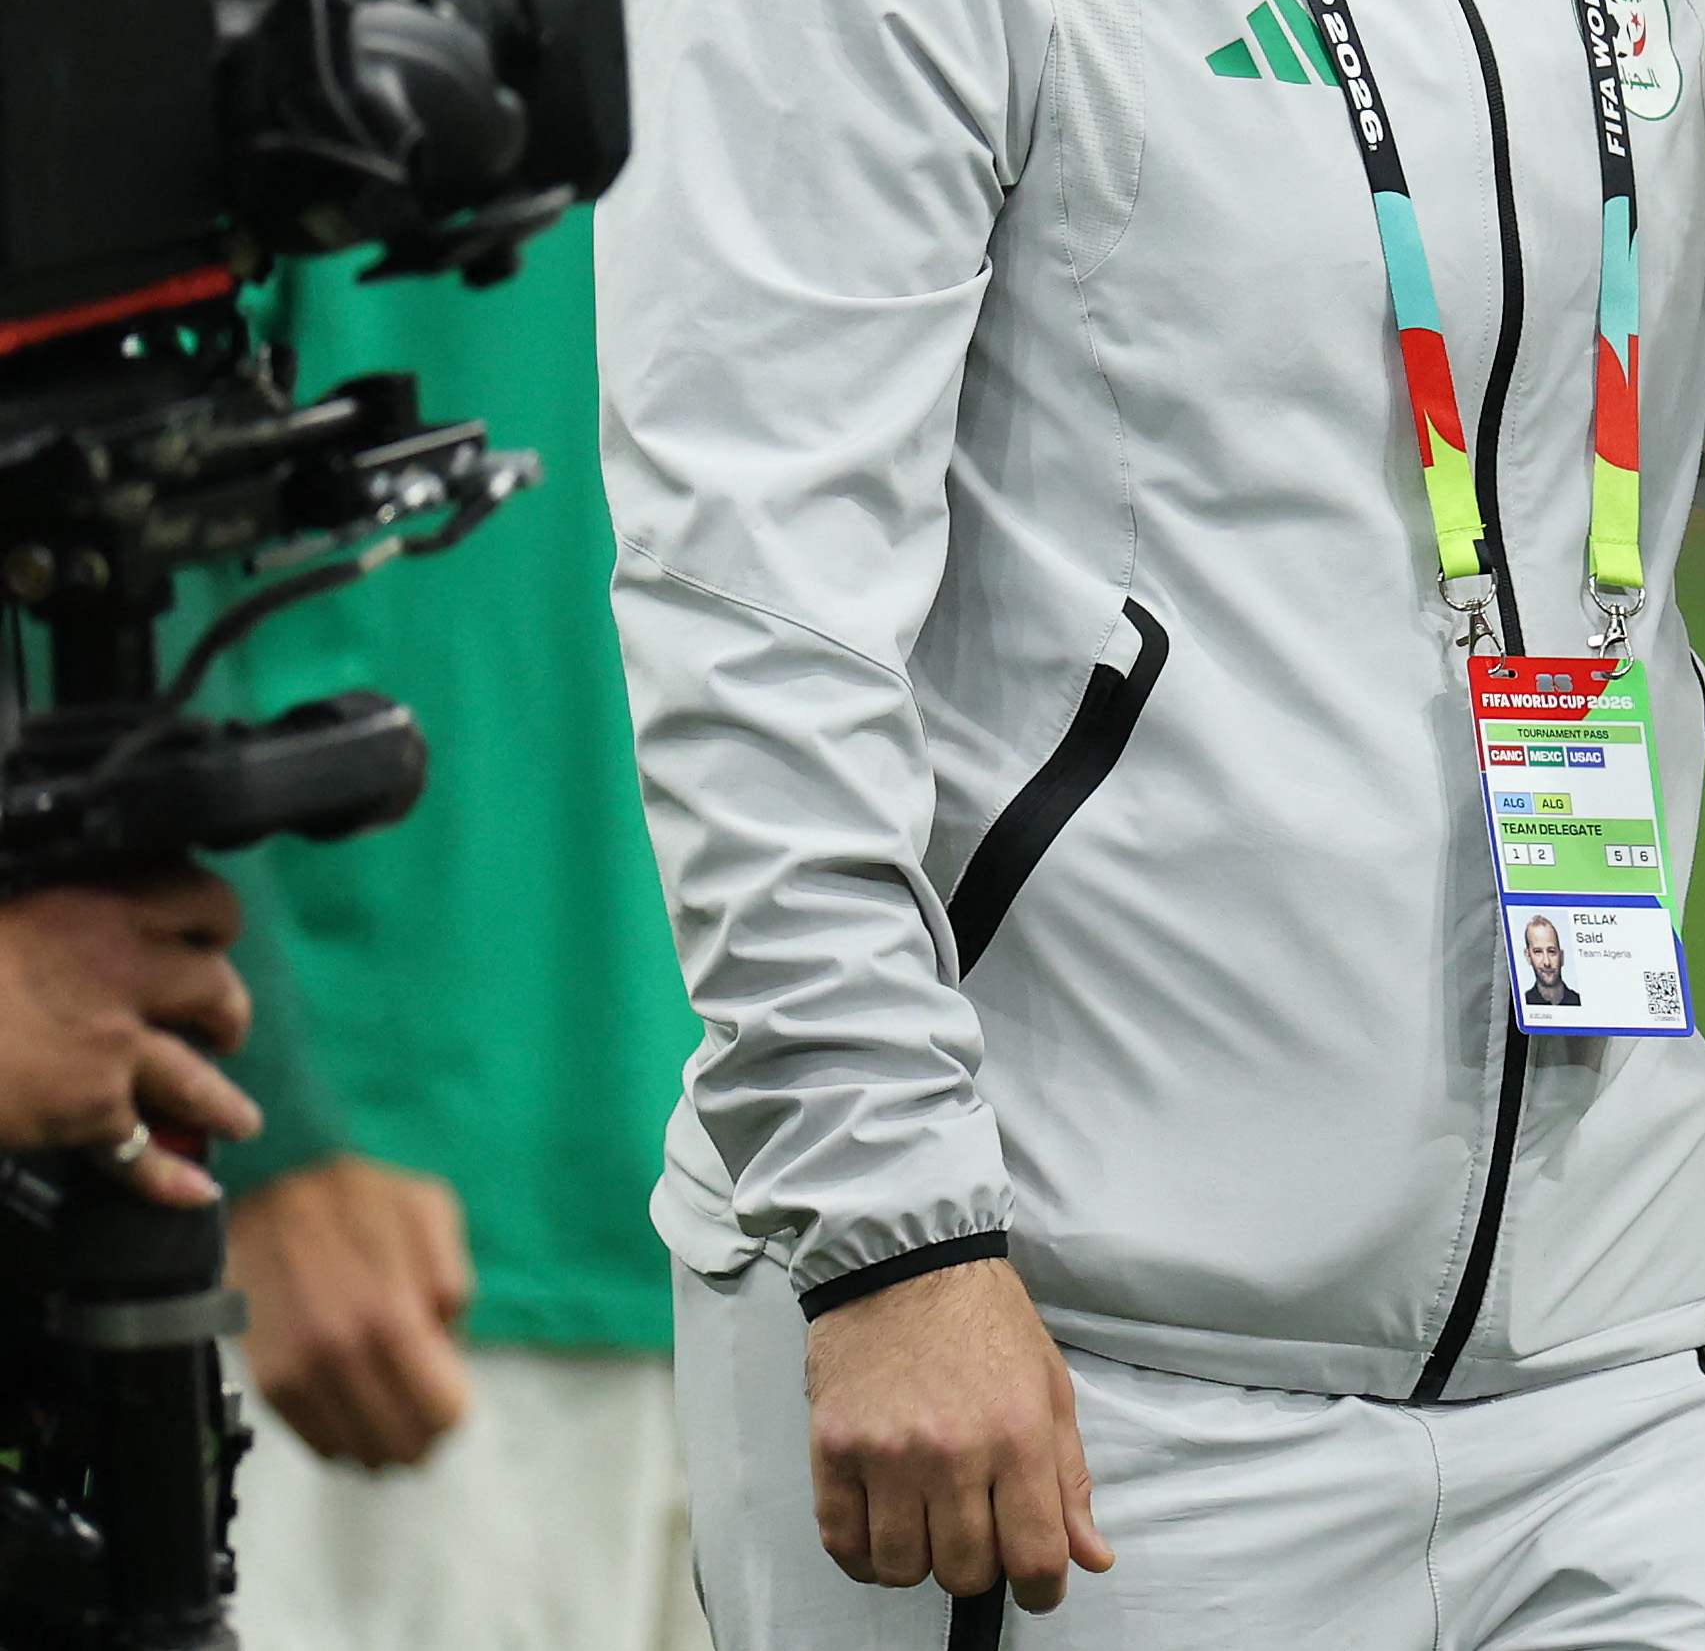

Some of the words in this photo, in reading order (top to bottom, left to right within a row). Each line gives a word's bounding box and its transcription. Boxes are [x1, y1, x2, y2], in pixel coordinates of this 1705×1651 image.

[1322, 12, 1384, 144] 2026
[1599, 77, 1626, 157] FIFA
[1482, 693, 1512, 708] FIFA
[1512, 694, 1558, 709] WORLD
[1559, 695, 1586, 709] CUP
[1587, 696, 1633, 710] 2026
[1518, 728, 1581, 739] TOURNAMENT
[1583, 730, 1610, 740] PASS
[1490, 750, 1524, 762] CANC
[1530, 751, 1563, 762] MEXC
[1503, 798, 1526, 809] ALG
[1542, 799, 1564, 810] ALG
[1502, 822, 1537, 835] TEAM
[1539, 824, 1603, 836] DELEGATE
[1513, 848, 1521, 860] 1
[1537, 849, 1546, 860] 2
[1614, 850, 1623, 862] 5
[1640, 851, 1649, 862] 6
[1573, 913, 1618, 926] FELLAK
[1578, 949, 1601, 958] Team
[1603, 949, 1632, 960] Algeria
